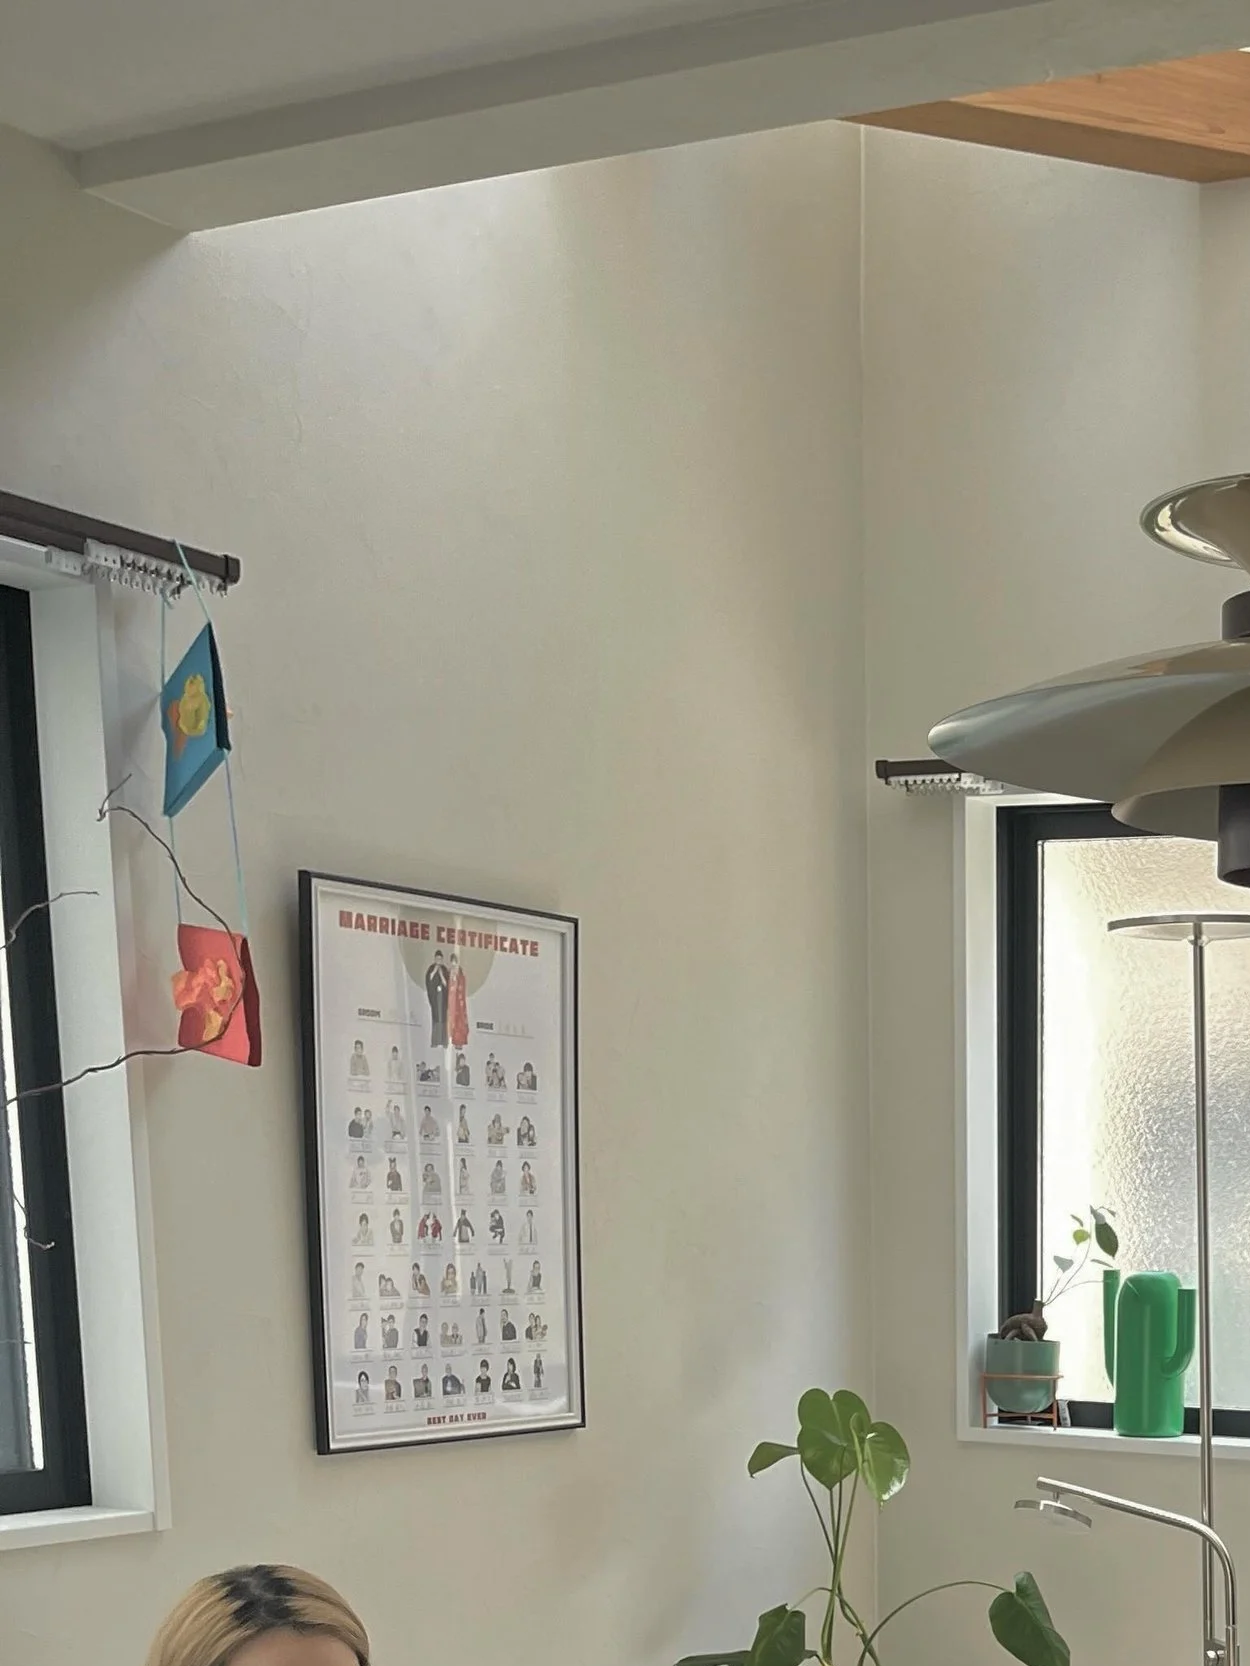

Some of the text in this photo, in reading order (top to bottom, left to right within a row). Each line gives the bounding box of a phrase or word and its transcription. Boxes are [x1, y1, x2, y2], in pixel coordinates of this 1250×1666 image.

[339, 910, 539, 957] MARRIAGE CERTIFICATE
[427, 1412, 487, 1425] BEST DAY EVER
